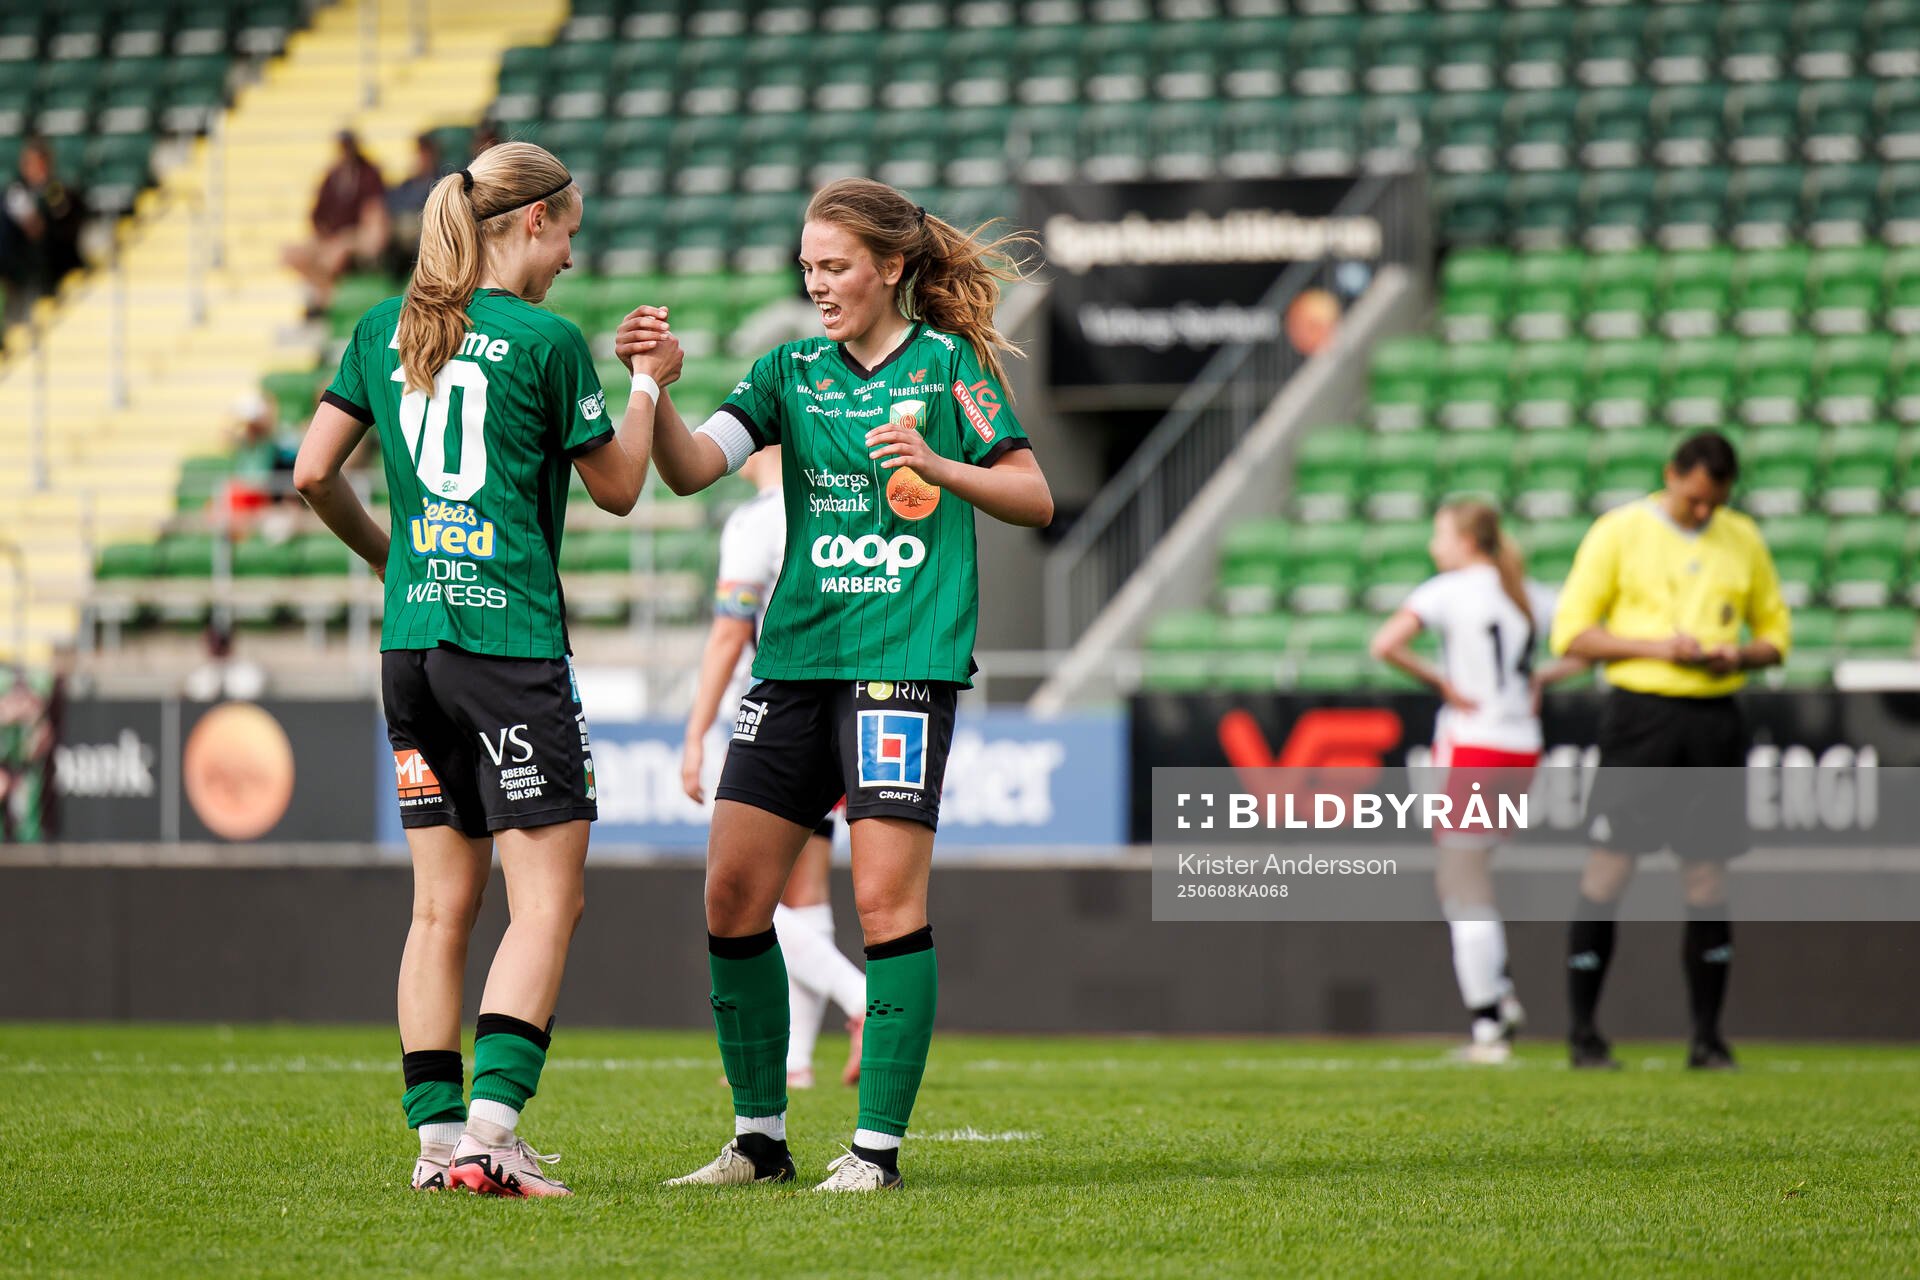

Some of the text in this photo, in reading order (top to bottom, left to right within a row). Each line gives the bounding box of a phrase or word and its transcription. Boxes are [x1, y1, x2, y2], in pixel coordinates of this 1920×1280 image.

[823, 392, 847, 401] ENERGI
[853, 380, 886, 396] DELUXE
[889, 383, 945, 397] VARBERG ENERGI
[969, 380, 1002, 422] ICA
[954, 382, 993, 440] KVANTUM
[803, 468, 870, 493] Varbergs
[811, 534, 926, 576] coop
[821, 576, 902, 594] VARBERG
[479, 724, 534, 766] VS
[423, 796, 443, 805] PUTS
[524, 787, 543, 799] SPA
[879, 790, 914, 802] CRAFT
